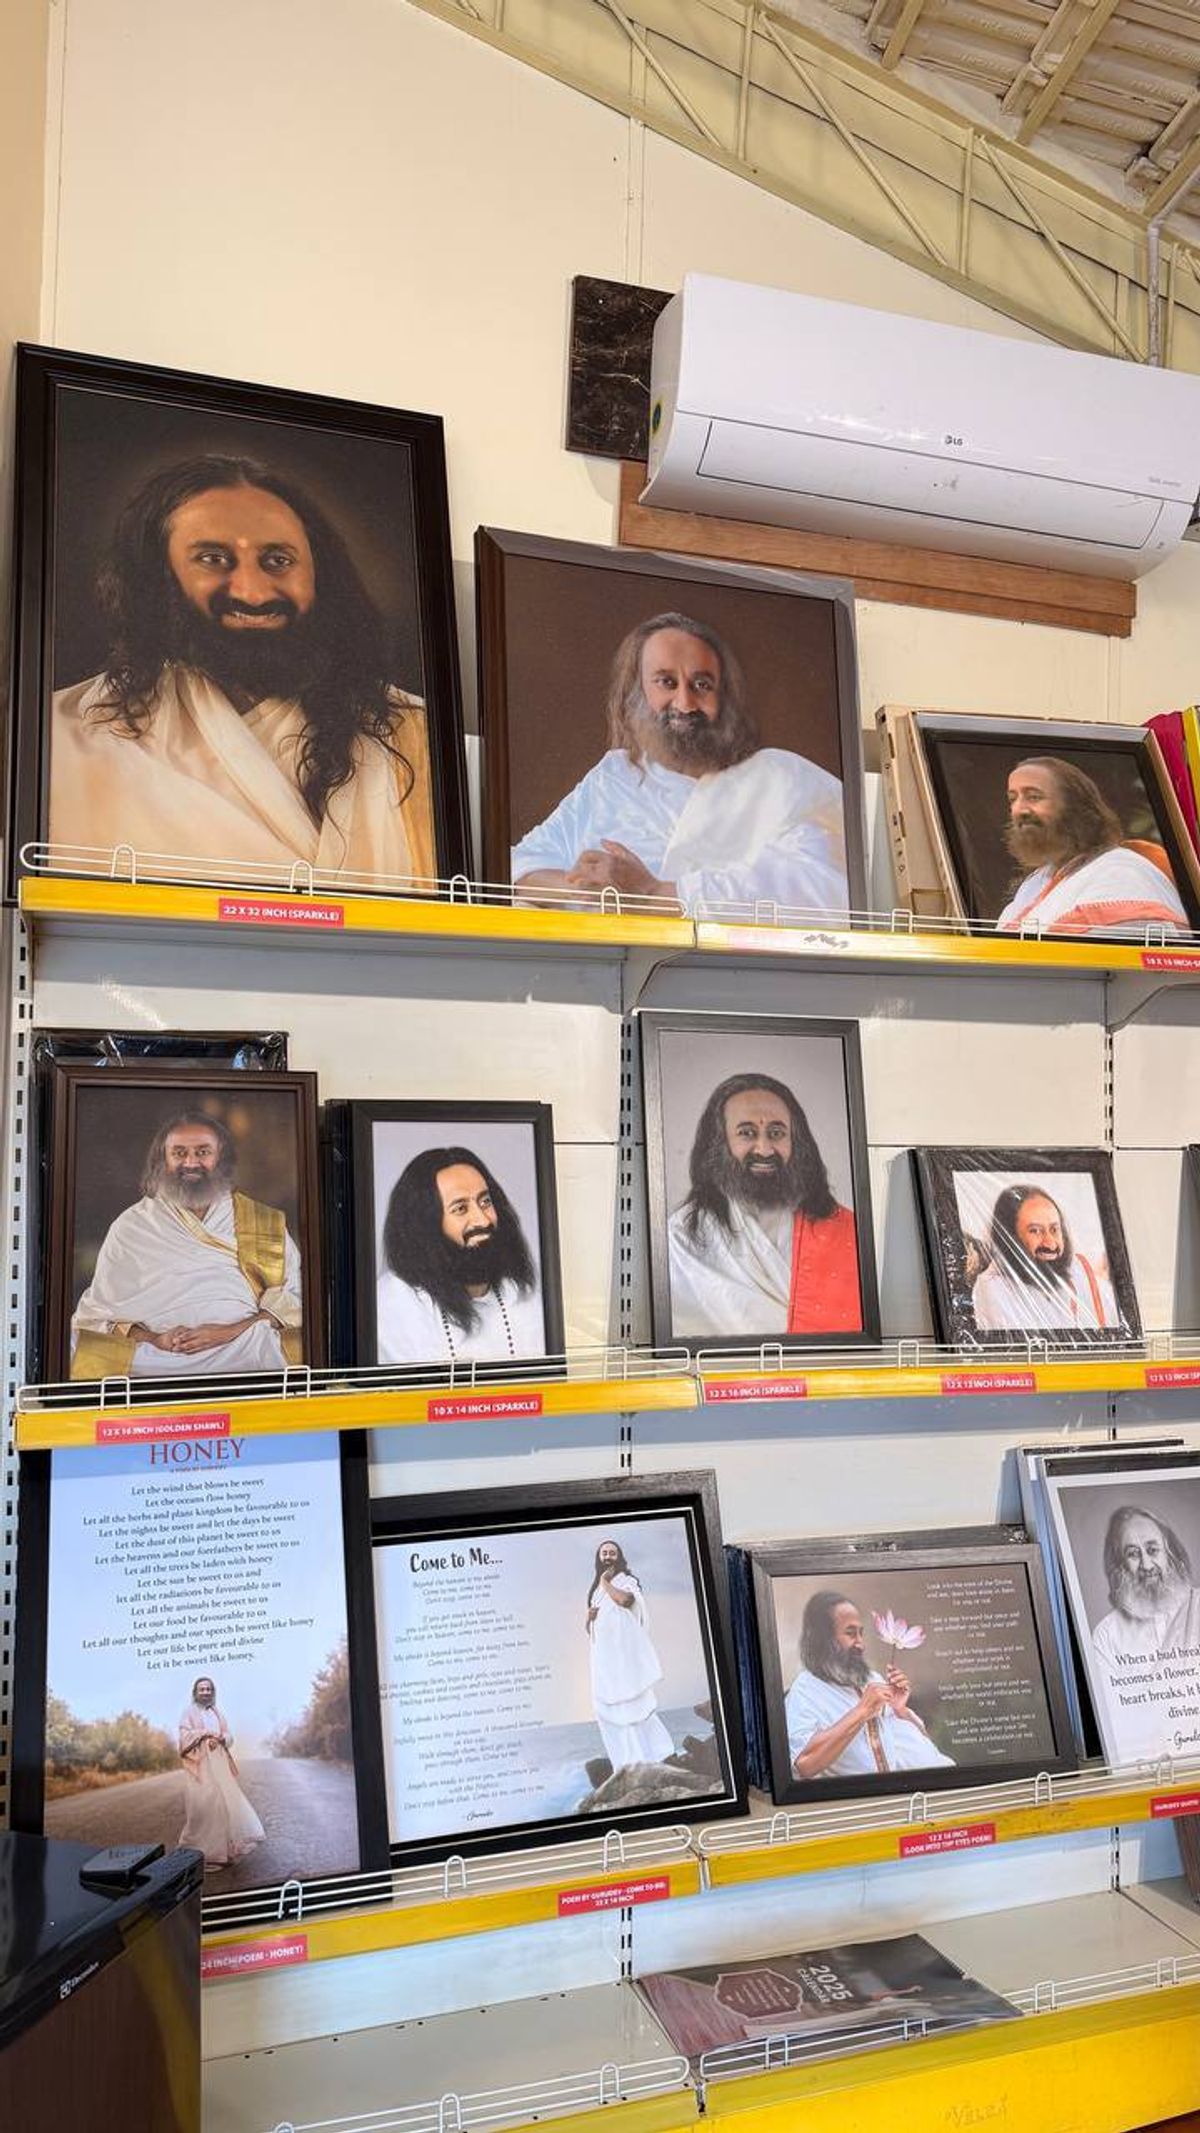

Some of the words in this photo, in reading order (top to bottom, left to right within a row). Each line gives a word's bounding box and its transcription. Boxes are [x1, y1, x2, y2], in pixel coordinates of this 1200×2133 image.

[224, 905, 237, 914] 22
[238, 906, 245, 915] X
[248, 907, 259, 916] 32
[262, 908, 287, 918] INCH
[289, 909, 339, 921] (SPARKLE)
[739, 1388, 761, 1396] INCH
[973, 1380, 993, 1388] INCH
[456, 1406, 466, 1414] 14
[468, 1404, 491, 1413] INCH
[491, 1401, 538, 1412] (SPARKLE)
[103, 1428, 114, 1436] 12
[114, 1428, 120, 1436] X
[132, 1426, 153, 1435] INCH
[150, 1438, 245, 1464] HONEY
[131, 1487, 144, 1495] Let
[146, 1485, 160, 1493] the
[162, 1483, 183, 1491] wind
[185, 1482, 202, 1490] that
[204, 1481, 228, 1489] blows
[205, 1493, 223, 1501] flow
[226, 1492, 250, 1501] honey
[83, 1516, 96, 1525] Let
[98, 1515, 109, 1523] all
[127, 1512, 151, 1521] herbs
[153, 1510, 169, 1519] and
[171, 1509, 193, 1520] plant
[195, 1507, 232, 1515] kingdom
[234, 1504, 243, 1512] be
[245, 1501, 287, 1510] favourable
[130, 1526, 157, 1535] nights
[159, 1524, 169, 1532] be
[196, 1520, 212, 1528] and
[213, 1519, 224, 1527] let
[226, 1518, 239, 1526] the
[241, 1517, 260, 1526] days
[261, 1515, 270, 1523] be
[131, 1539, 145, 1547] the
[146, 1538, 165, 1546] dust
[167, 1535, 177, 1544] of
[178, 1535, 194, 1543] this
[196, 1533, 222, 1543] planet
[224, 1531, 234, 1539] be
[124, 1567, 137, 1575] Let
[139, 1565, 150, 1573] all
[153, 1564, 166, 1572] the
[202, 1559, 225, 1567] laden
[410, 1552, 449, 1573] Come
[452, 1551, 465, 1568] to
[469, 1547, 503, 1567] Me...
[130, 1607, 144, 1615] Let
[146, 1605, 157, 1613] all
[159, 1604, 173, 1612] the
[176, 1600, 209, 1610] animals
[211, 1599, 220, 1607] be
[223, 1598, 245, 1606] sweet
[82, 1640, 96, 1648] Let
[98, 1637, 109, 1646] all
[129, 1633, 168, 1643] thoughts
[171, 1629, 186, 1638] and
[205, 1625, 233, 1637] speech
[235, 1624, 245, 1632] be
[247, 1622, 269, 1631] sweet
[137, 1648, 151, 1656] Let
[170, 1644, 184, 1652] life
[186, 1643, 196, 1651] be
[198, 1643, 217, 1652] pure
[220, 1638, 236, 1647] and
[237, 1637, 263, 1645] divine
[147, 1661, 160, 1669] Let
[171, 1659, 181, 1667] be
[184, 1656, 207, 1664] sweet
[209, 1654, 225, 1662] like
[227, 1653, 253, 1661] honey.
[1115, 1654, 1147, 1665] When
[1149, 1654, 1154, 1663] a
[1156, 1648, 1177, 1660] bud
[1110, 1673, 1154, 1687] becomes
[1156, 1672, 1162, 1680] a
[1163, 1667, 1199, 1679] flower.
[1119, 1693, 1146, 1706] heart
[1149, 1687, 1186, 1701] breaks,
[1187, 1684, 1195, 1696] it
[561, 1895, 580, 1904] POEM
[581, 1894, 589, 1902] BY
[591, 1889, 622, 1899] GURUDEV
[626, 1885, 644, 1894] COME
[270, 1945, 304, 1959] HONEY)
[808, 1965, 854, 2000] 2025
